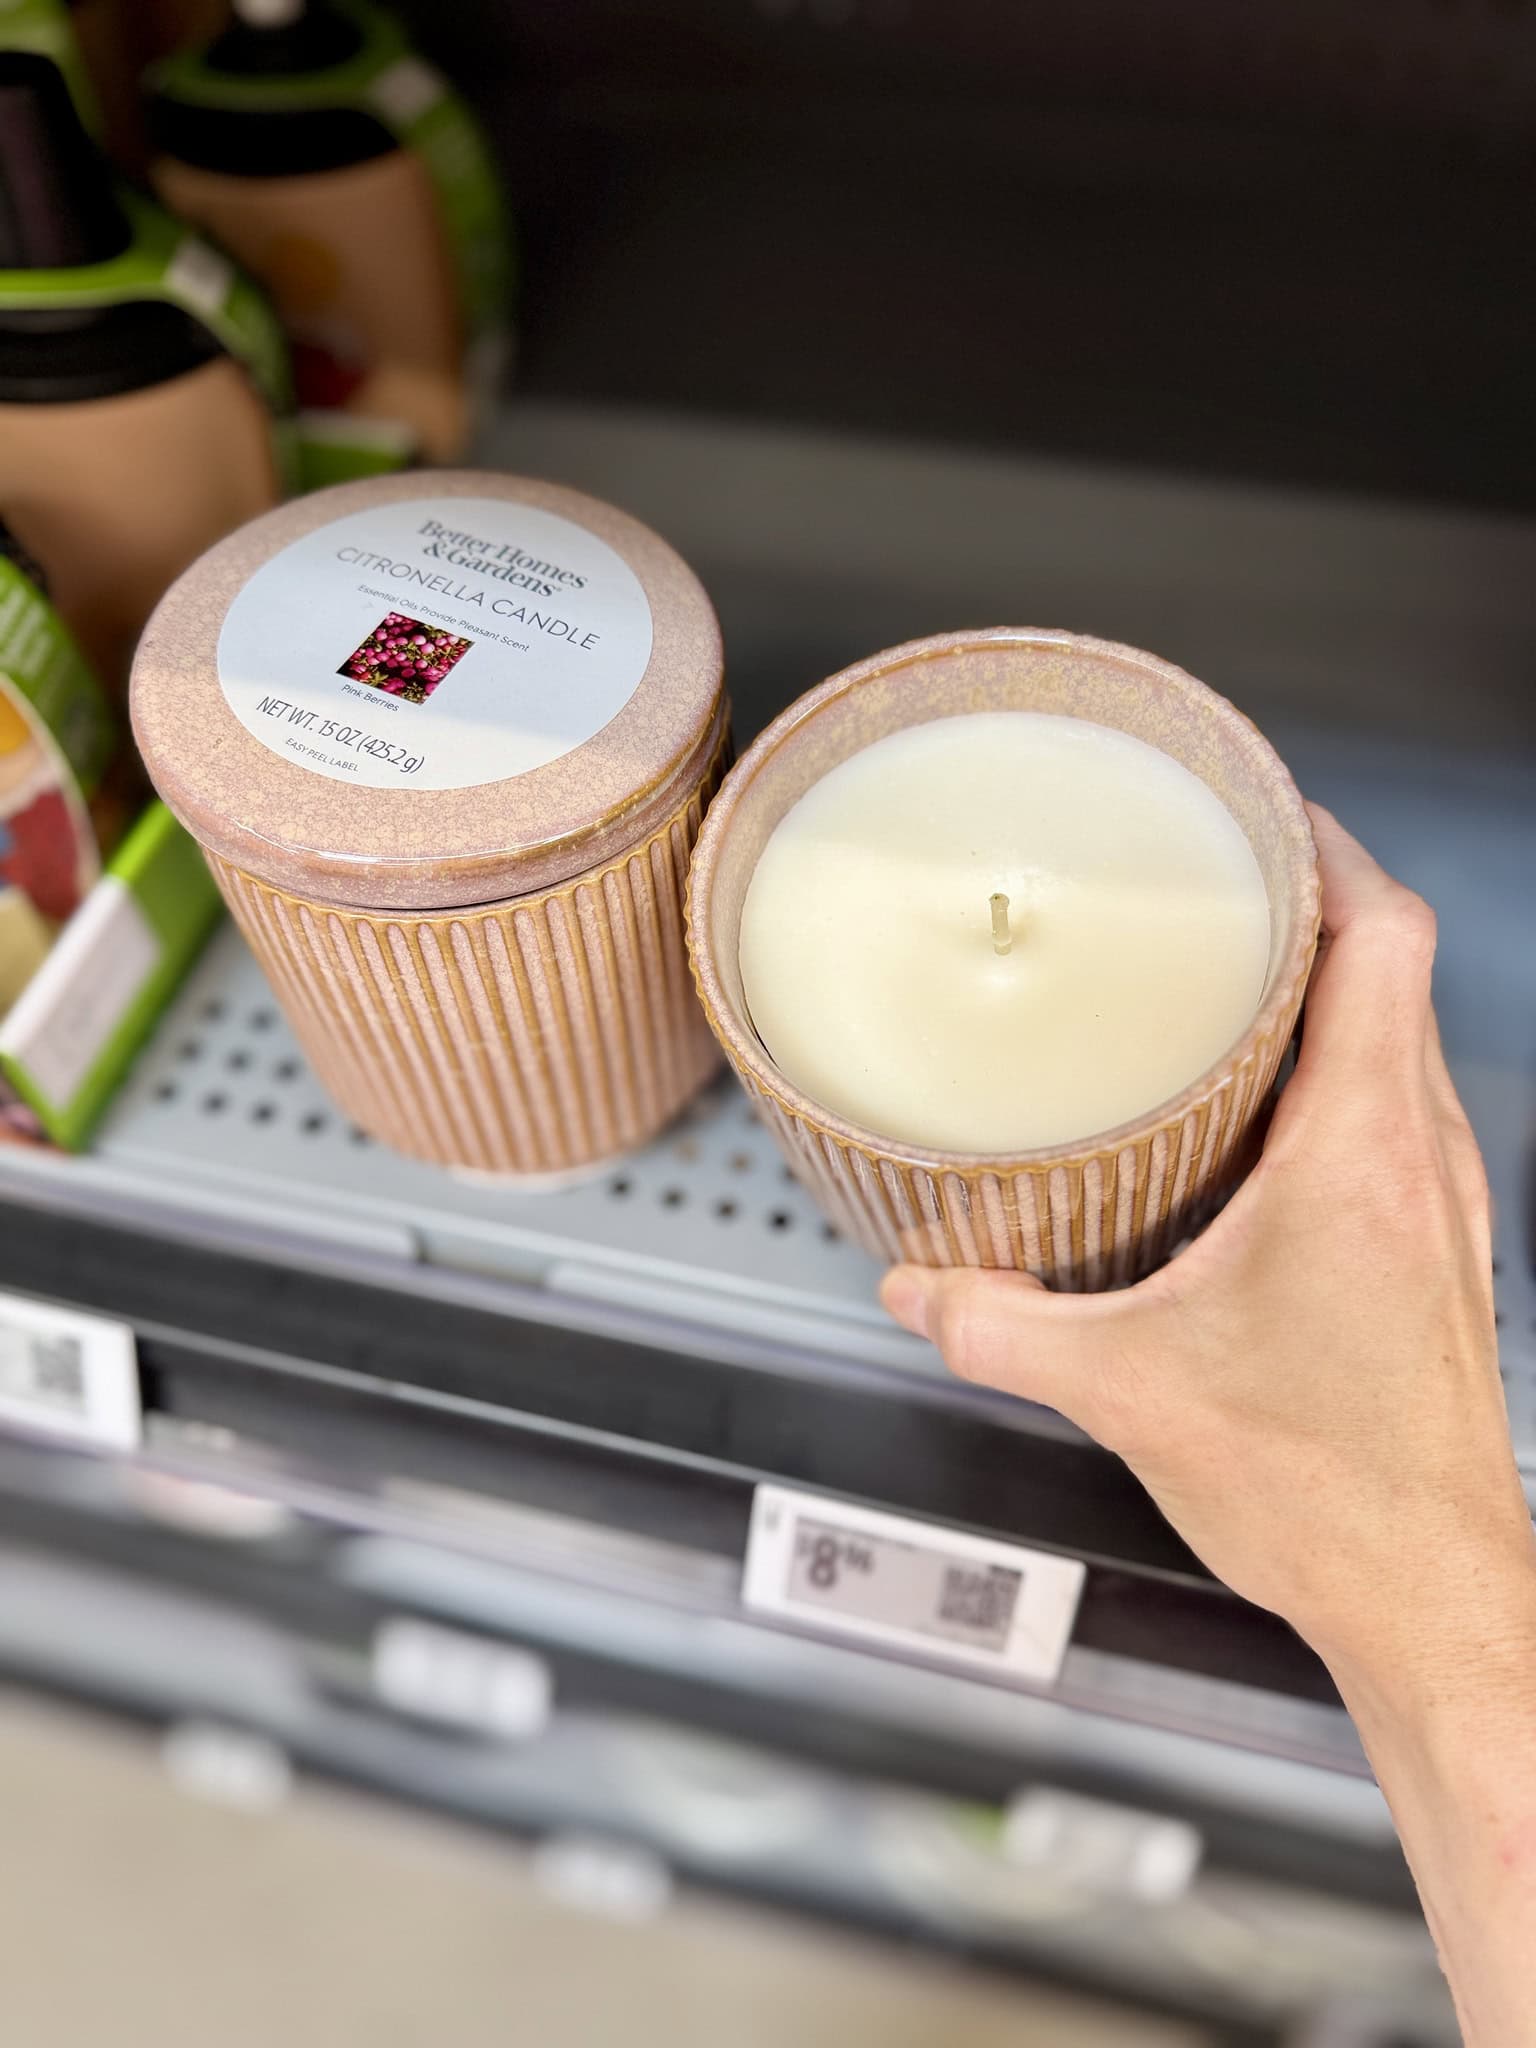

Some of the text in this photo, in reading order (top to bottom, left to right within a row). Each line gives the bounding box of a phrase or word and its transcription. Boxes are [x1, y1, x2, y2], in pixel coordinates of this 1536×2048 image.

[418, 520, 588, 589] Better Homes
[336, 546, 600, 650] CITRONELLA CANDLE
[358, 584, 530, 652] Essential Oils Provide Pleasant Scent
[256, 696, 292, 718] NET
[288, 707, 319, 730] WT.
[318, 719, 340, 737] 15
[335, 726, 362, 747] OZ
[341, 684, 400, 712] Pink Berries
[285, 738, 359, 772] EASY PEEL LABEL
